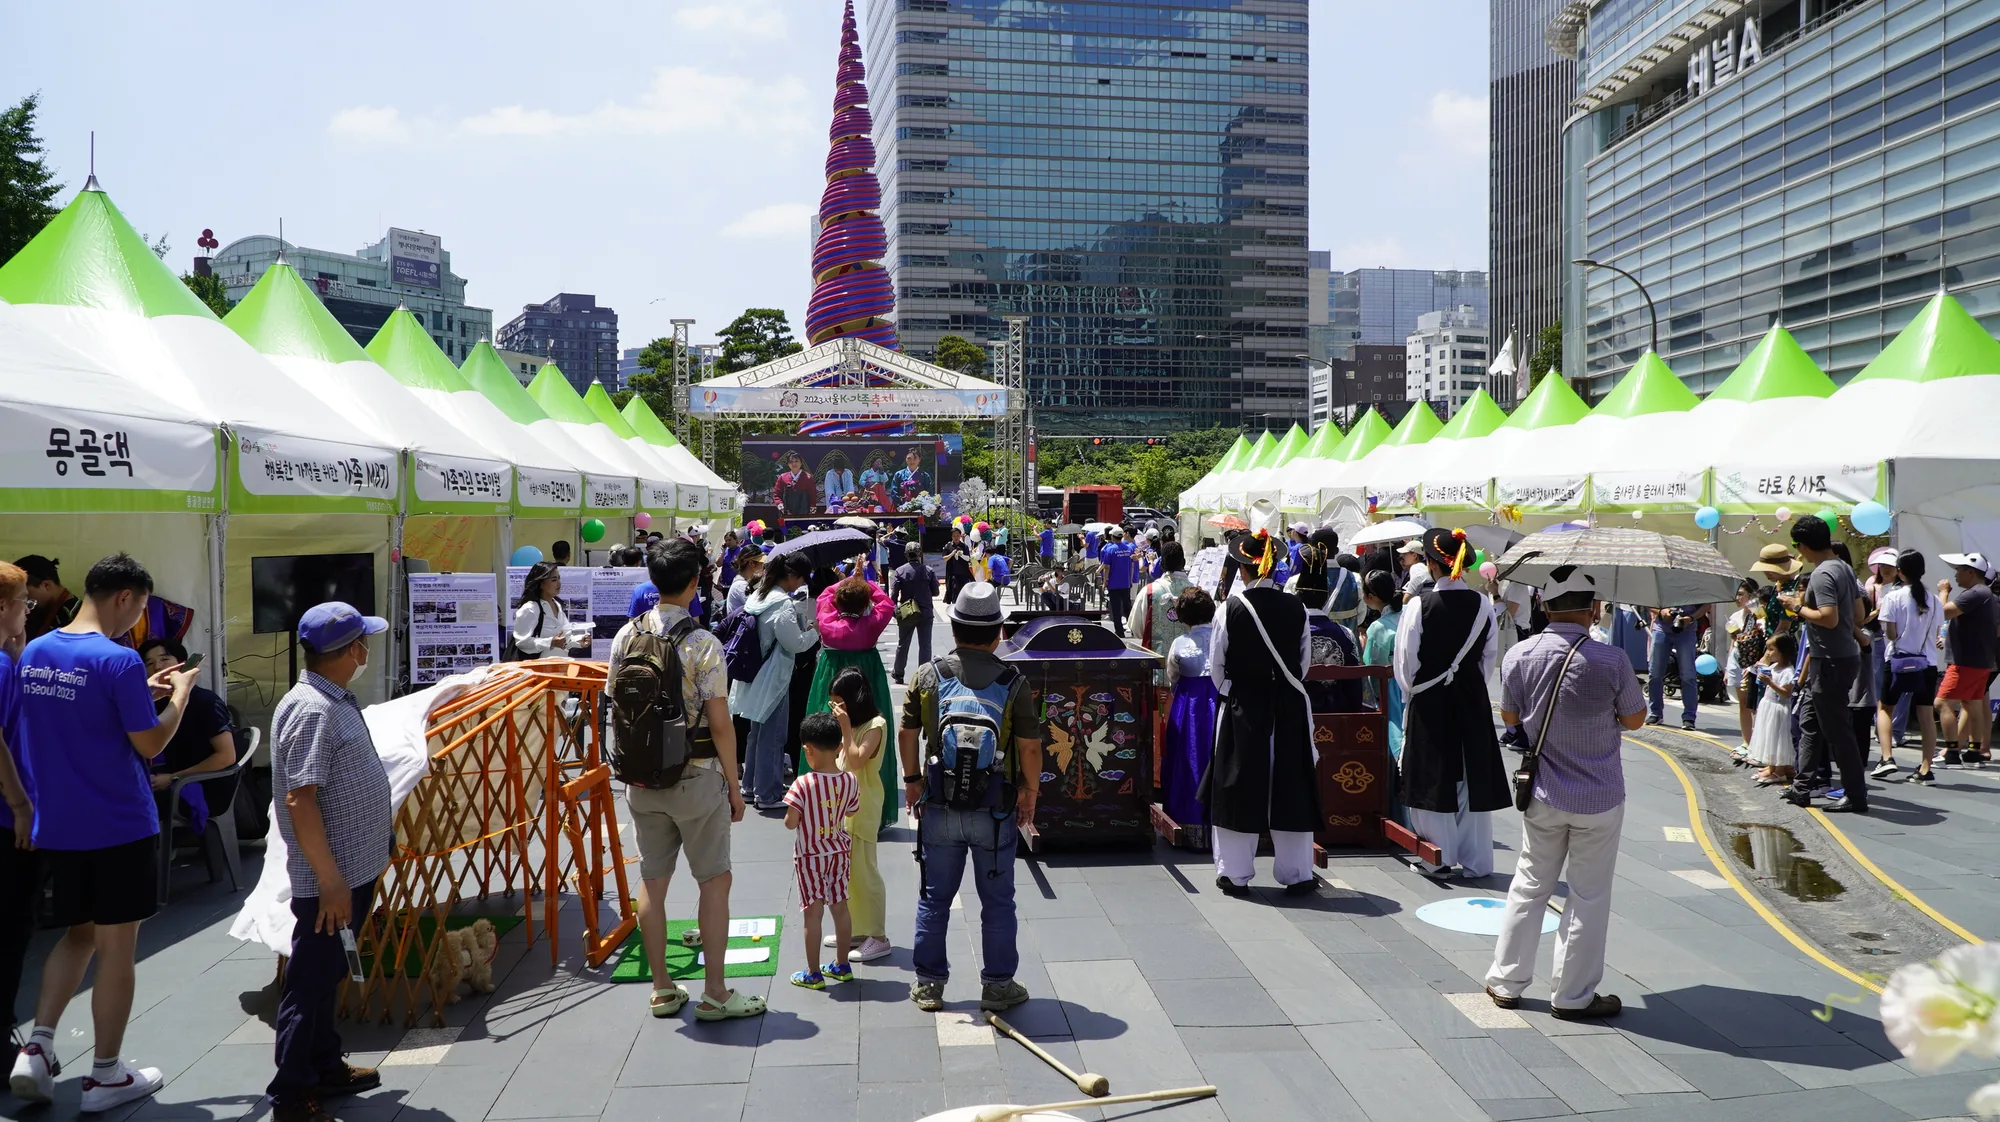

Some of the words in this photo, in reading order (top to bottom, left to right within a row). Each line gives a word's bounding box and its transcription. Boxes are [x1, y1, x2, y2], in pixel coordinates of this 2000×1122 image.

[1687, 16, 1762, 101] 채널A
[396, 266, 418, 277] TOEFL
[46, 428, 133, 477] 몽골댁
[265, 459, 293, 481] 행복한
[295, 462, 322, 482] 가정을
[323, 463, 338, 482] 위한
[338, 458, 364, 491] 가족
[366, 461, 389, 490] MBTI
[1614, 485, 1634, 500] 솜사탕
[1644, 483, 1664, 499] 슬러시
[1668, 482, 1686, 498] 먹자!
[1758, 476, 1782, 495] 타로
[1787, 475, 1795, 496] &
[1797, 475, 1827, 497] 사주
[55, 668, 87, 686] Festival
[31, 682, 56, 696] Seoul
[57, 685, 76, 701] 2023
[961, 755, 972, 791] MILLET
